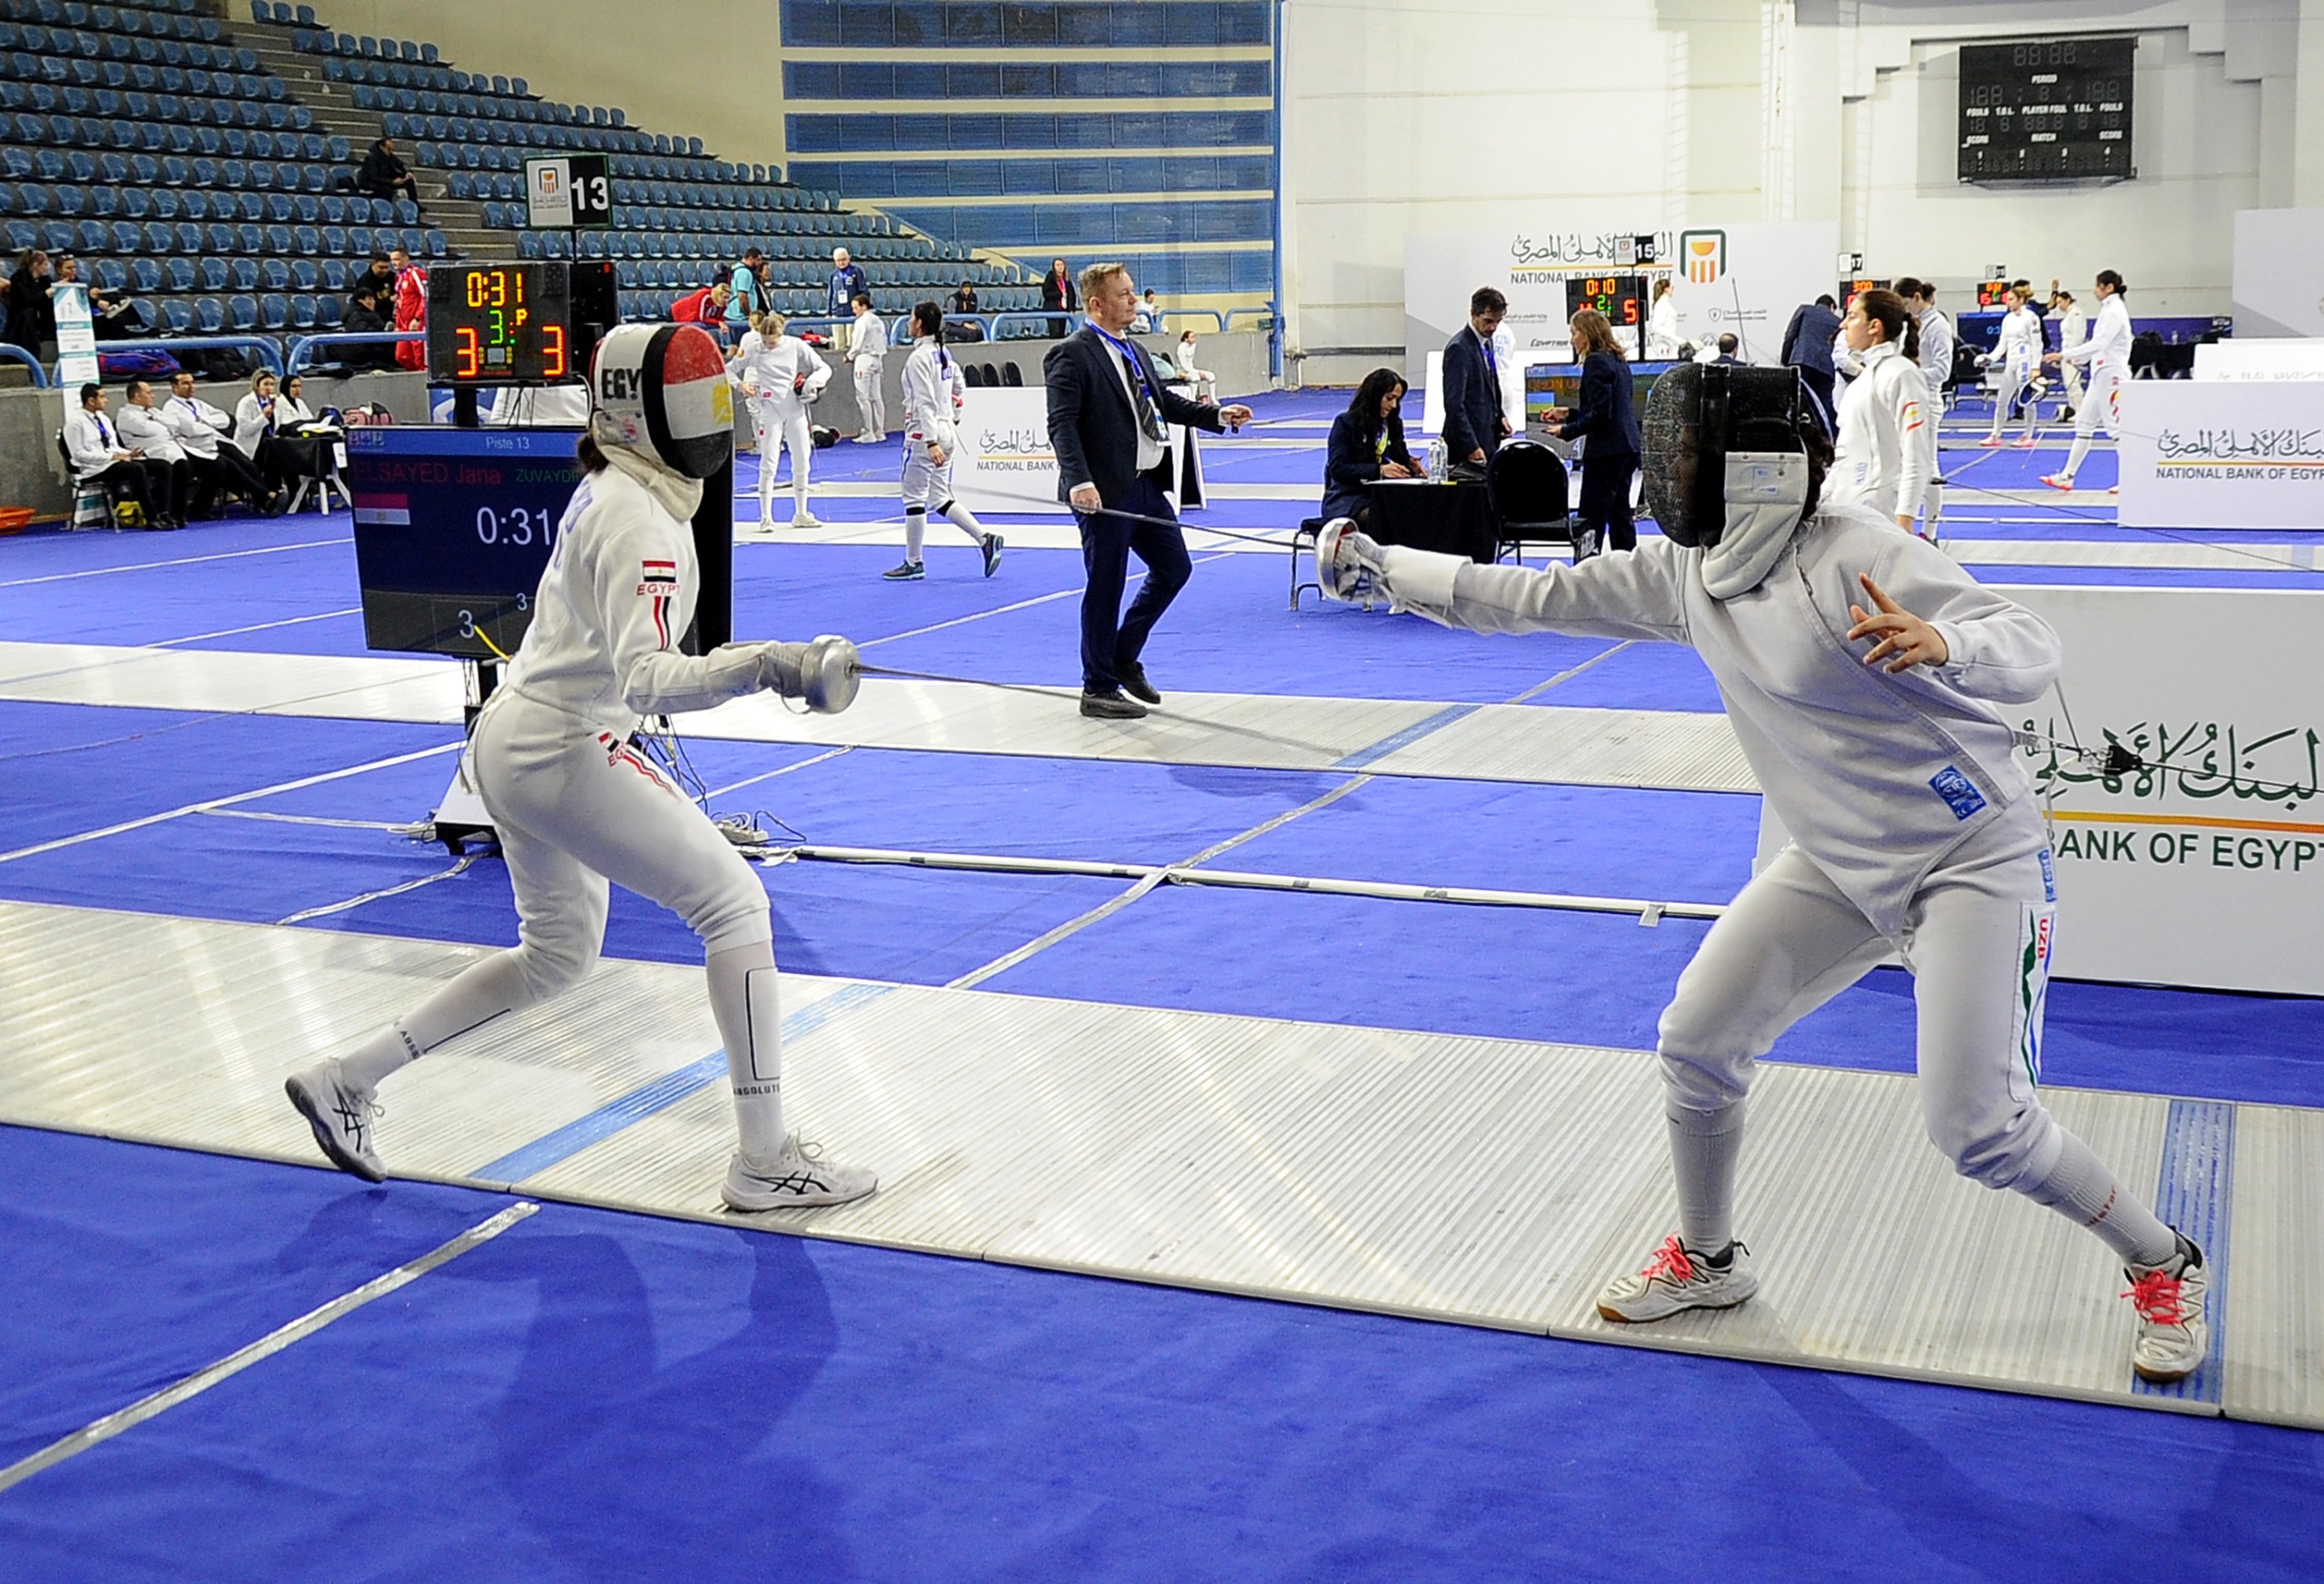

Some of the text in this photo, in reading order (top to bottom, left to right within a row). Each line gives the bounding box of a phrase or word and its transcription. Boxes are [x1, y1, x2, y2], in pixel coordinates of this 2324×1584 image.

[2032, 74, 2058, 84] PERIOD
[1966, 107, 1990, 117] FOULS
[2022, 104, 2068, 114] PLAYER FOUL
[2099, 103, 2123, 112] FOULS
[1966, 135, 1990, 144] SCORE
[2031, 133, 2057, 143] MATCH
[2099, 131, 2123, 140] SCORE
[571, 176, 608, 211] 13
[1635, 243, 1654, 260] 15
[1851, 258, 1862, 268] 17
[467, 272, 523, 307] 0:31
[1586, 278, 1616, 296] 0:10
[1597, 294, 1606, 310] 2
[515, 309, 527, 326] P
[1623, 298, 1638, 324] 5
[489, 310, 504, 345] 3
[456, 328, 478, 376] 3
[542, 326, 564, 375] 3
[602, 368, 643, 399] EGY
[486, 436, 530, 450] Piste 13
[353, 463, 501, 485] ELSAYED Jana
[977, 461, 1024, 470] NATIONAL
[1027, 461, 1054, 470] BANK
[2156, 467, 2222, 480] NATIONAL
[2226, 467, 2264, 480] BANK
[2269, 467, 2287, 480] OF
[477, 507, 551, 546] 0:31
[636, 583, 680, 595] EGYPT
[516, 593, 527, 611] 3
[458, 609, 475, 639] 3
[2149, 832, 2200, 863] OF
